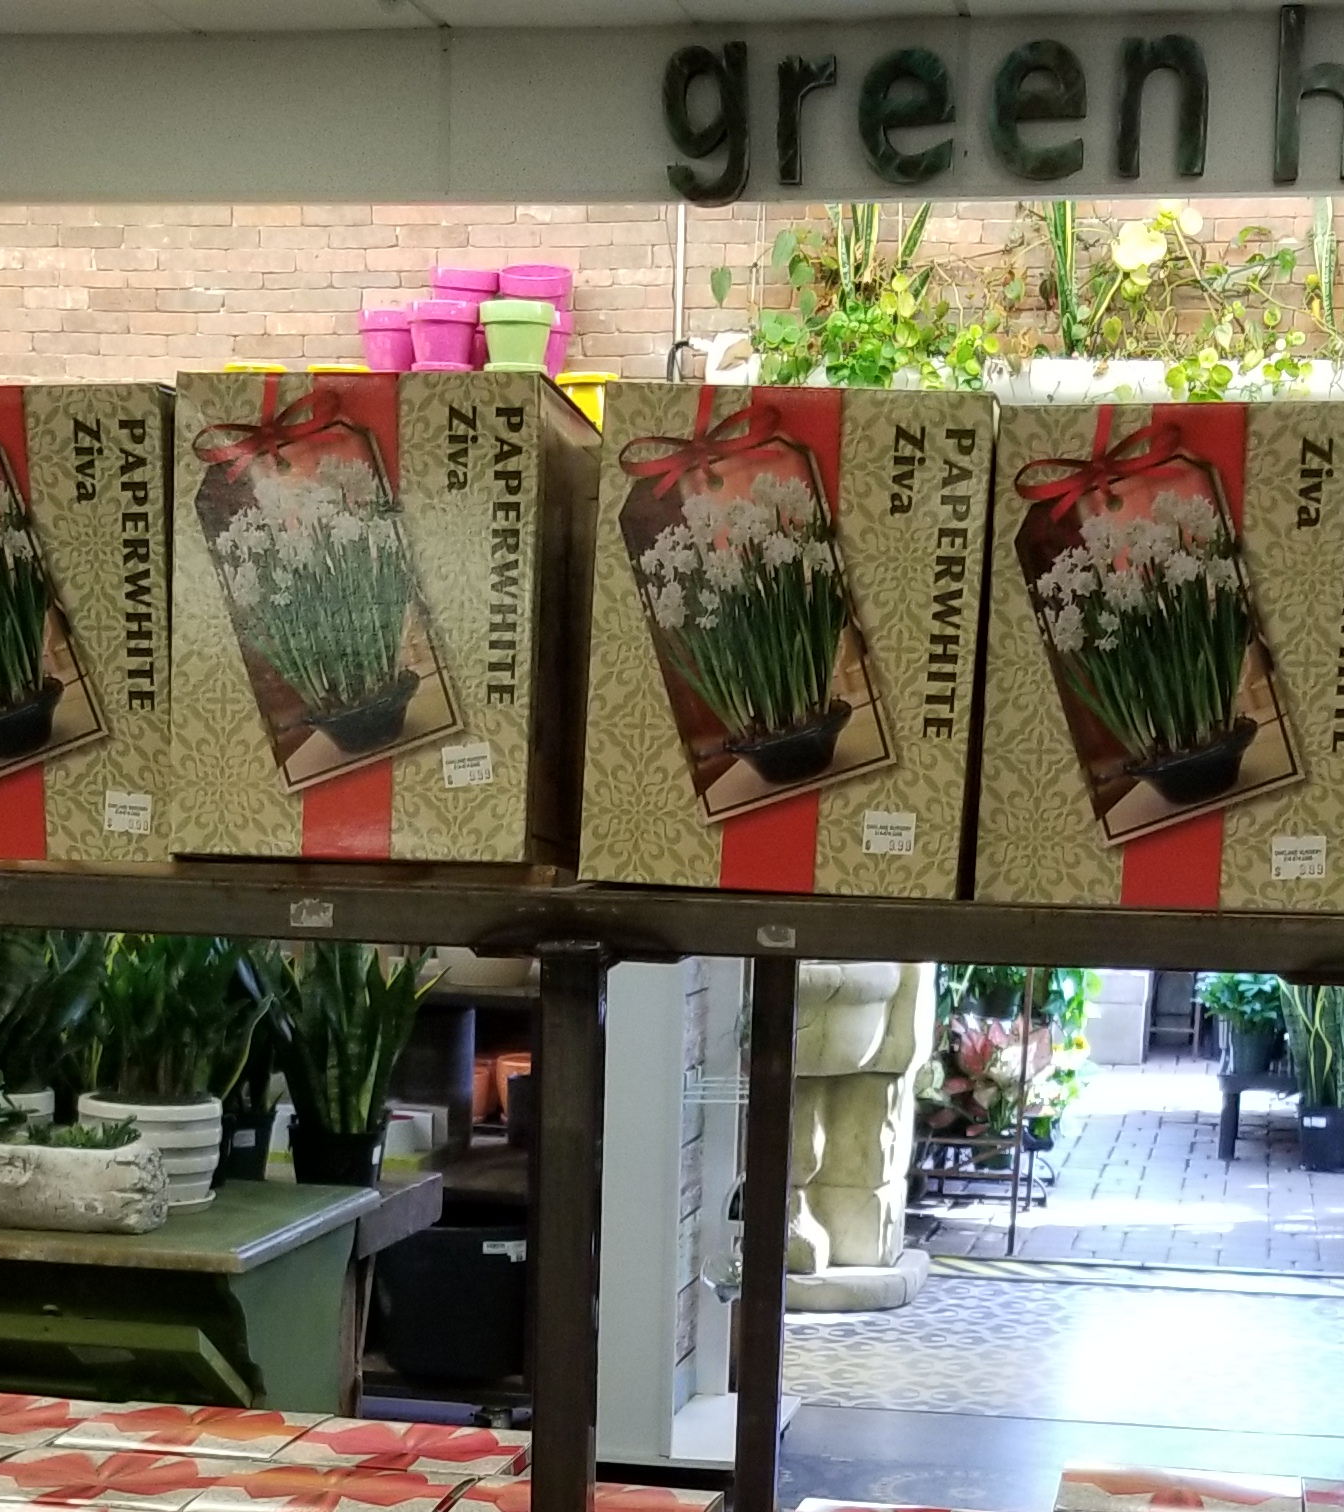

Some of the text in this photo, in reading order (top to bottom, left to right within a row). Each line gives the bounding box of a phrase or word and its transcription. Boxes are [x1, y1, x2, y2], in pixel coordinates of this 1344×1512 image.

[662, 30, 1209, 207] green
[72, 418, 100, 504] Ziva
[446, 405, 478, 493] Ziva
[890, 424, 926, 517] Ziva
[1295, 437, 1334, 530] Ziva
[118, 419, 155, 711] PAPERWHITE
[485, 406, 524, 706] PAPERWHITE
[922, 428, 976, 739] PAPERWHITE
